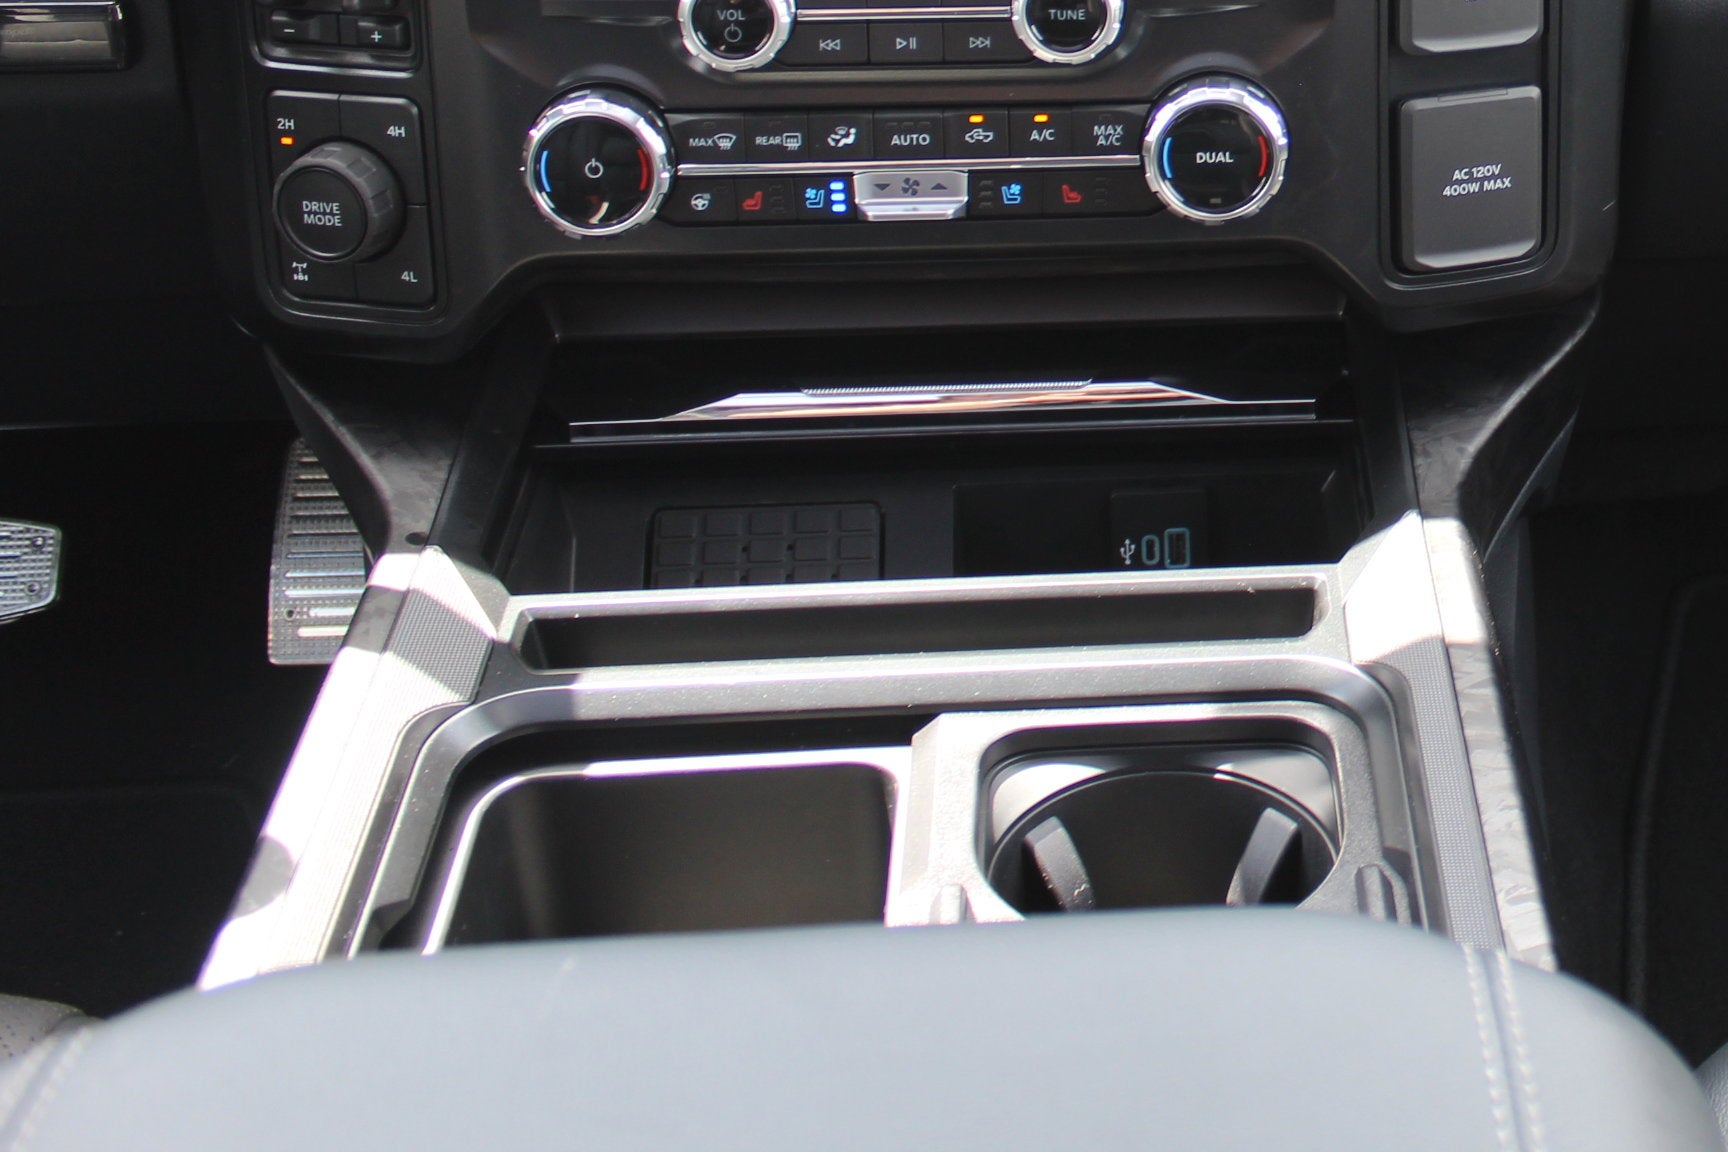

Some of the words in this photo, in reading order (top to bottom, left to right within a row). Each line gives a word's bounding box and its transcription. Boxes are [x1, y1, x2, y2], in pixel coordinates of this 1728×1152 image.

[717, 9, 746, 21] VOL
[1048, 9, 1086, 21] TUNE
[276, 118, 295, 130] 2H
[1093, 124, 1123, 136] MAX
[386, 125, 406, 138] 4H
[1029, 128, 1055, 141] A/C
[688, 137, 714, 148] MAX
[755, 135, 782, 146] REAR
[890, 133, 931, 147] AUTO
[1096, 134, 1122, 147] A/C
[1195, 151, 1234, 164] DUAL
[1452, 168, 1470, 181] AC
[1471, 164, 1503, 179] 120V
[1441, 182, 1481, 198] 400W
[1482, 176, 1512, 192] MAX
[302, 200, 341, 214] DRIVE
[303, 214, 343, 227] MODE
[400, 270, 418, 283] 4L
